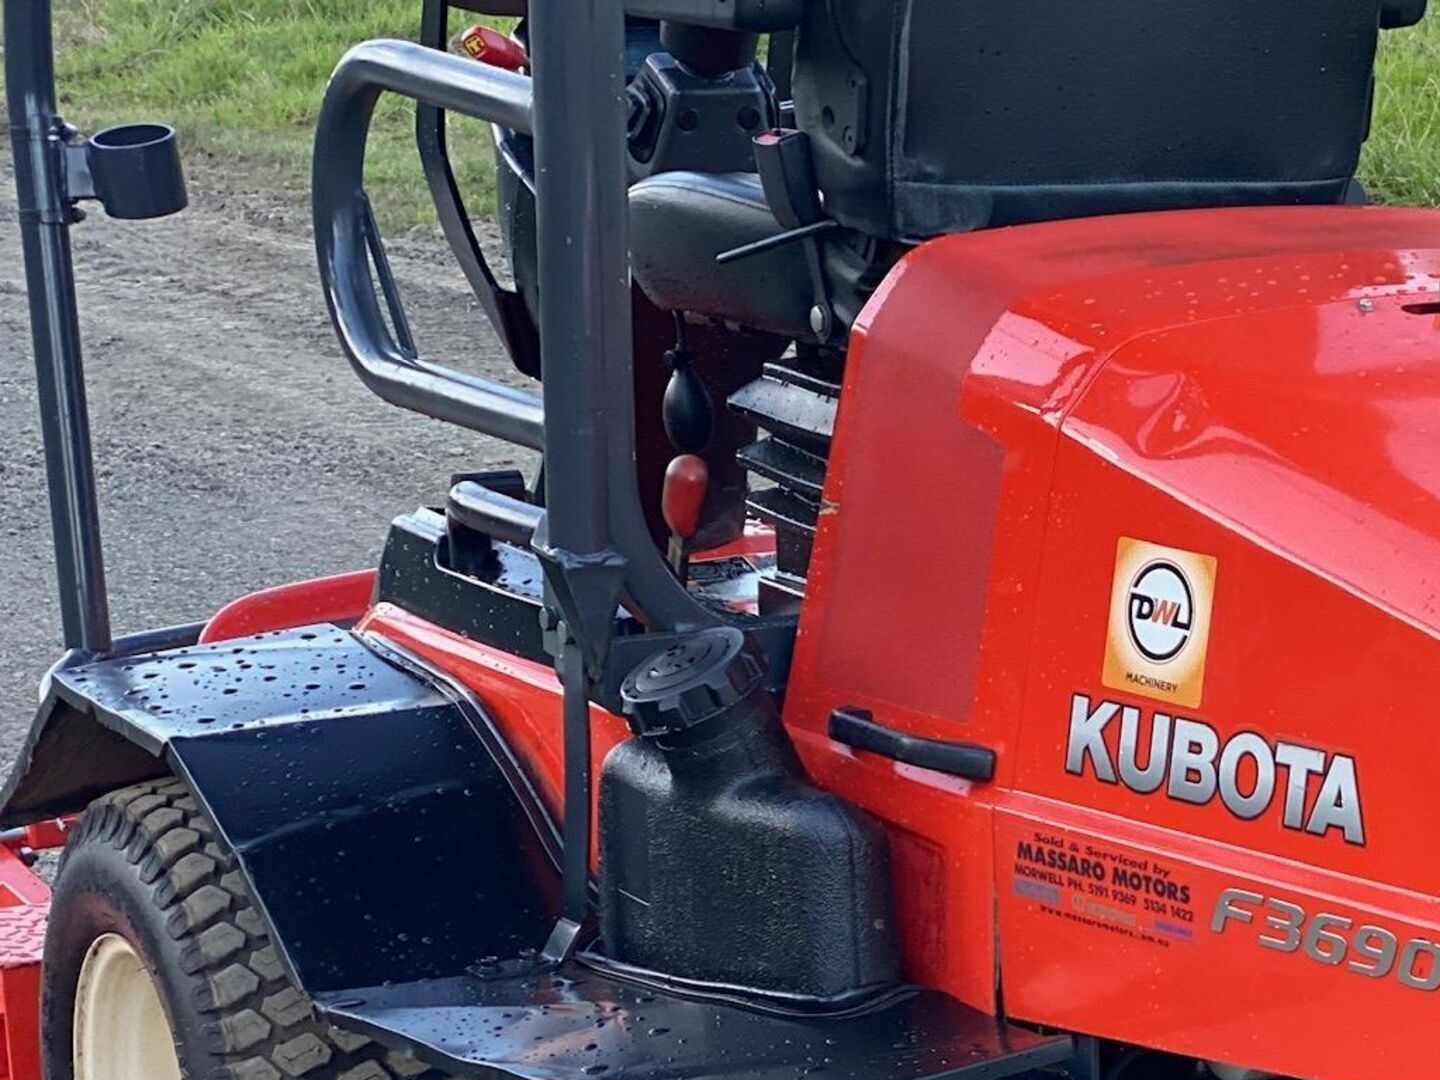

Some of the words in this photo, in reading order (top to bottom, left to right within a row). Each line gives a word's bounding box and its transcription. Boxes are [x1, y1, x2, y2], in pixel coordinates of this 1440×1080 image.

[1130, 592, 1191, 631] DWL
[1125, 671, 1179, 695] MACHINERY
[1064, 693, 1367, 847] KUBOTA
[1017, 841, 1106, 881] MASSARO
[1112, 867, 1191, 904] MOTORS
[1034, 832, 1064, 849] Sold
[1070, 843, 1080, 853] &
[1086, 846, 1148, 871] Serviced
[1152, 864, 1171, 879] by
[1014, 863, 1065, 888] MORWELL
[1067, 877, 1085, 893] PH.
